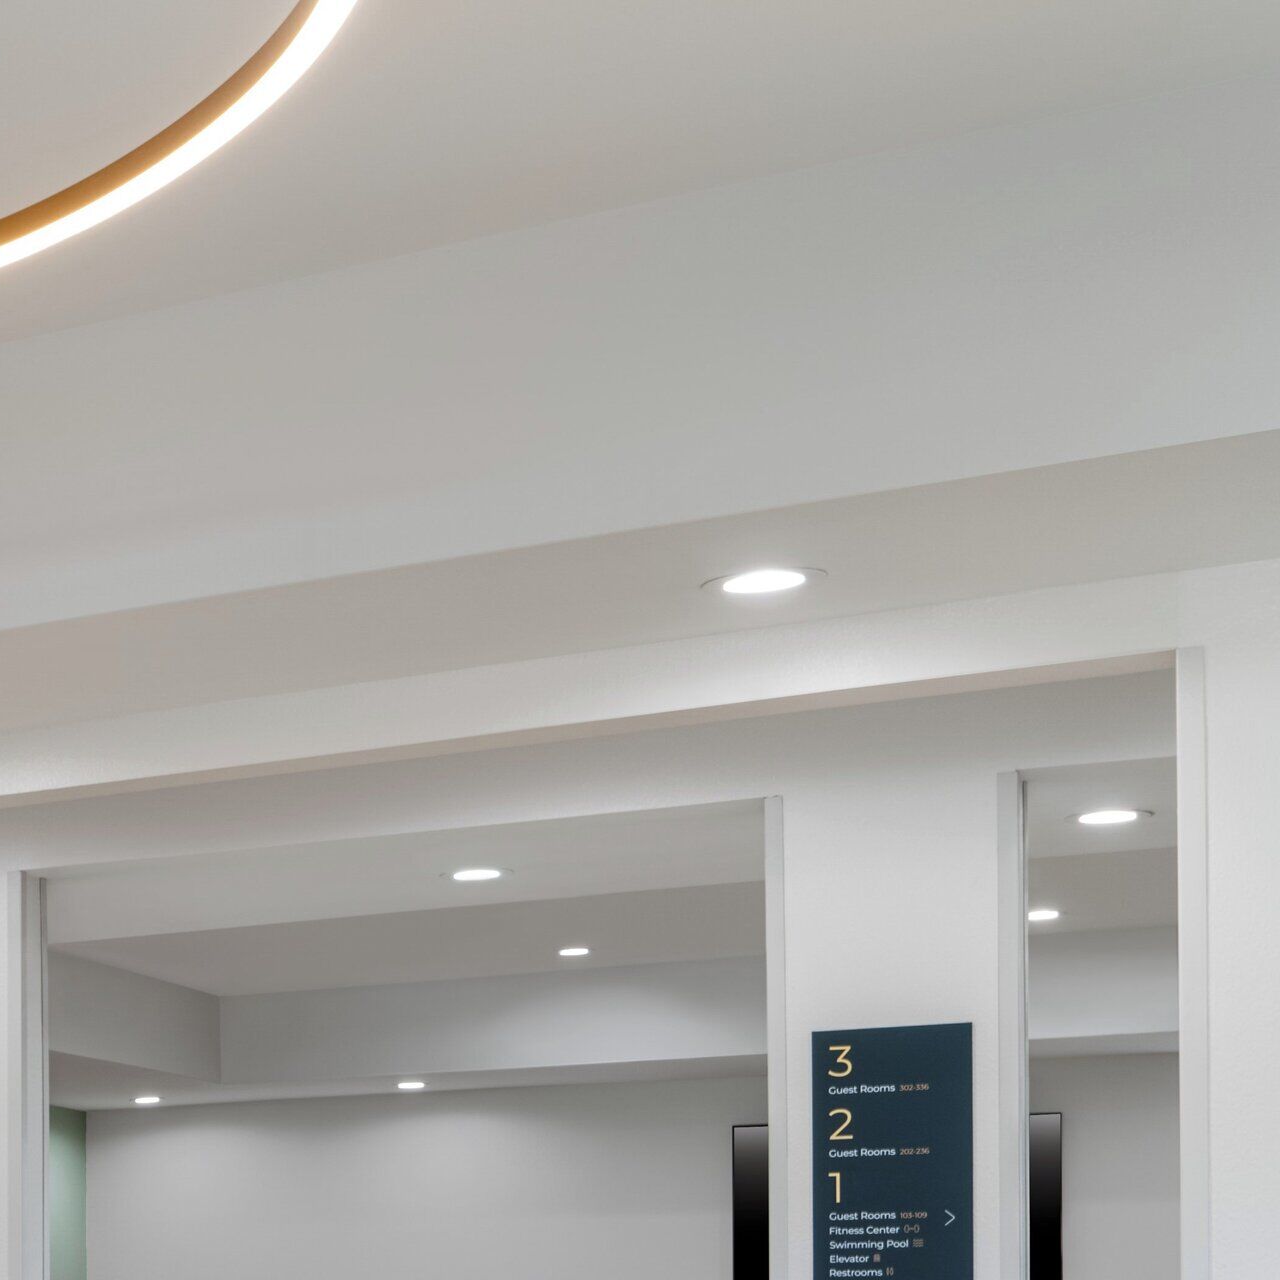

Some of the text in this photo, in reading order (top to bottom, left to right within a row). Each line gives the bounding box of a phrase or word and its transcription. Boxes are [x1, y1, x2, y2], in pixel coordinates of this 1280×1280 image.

[828, 1045, 853, 1078] 3
[828, 1083, 930, 1095] Guest Rooms 302-336
[828, 1108, 854, 1141] 2
[828, 1147, 930, 1158] Guest Rooms 202-236
[828, 1172, 841, 1203] 1
[829, 1211, 928, 1221] Guest Rooms 103-109
[829, 1225, 900, 1235] Fitness Center
[829, 1239, 909, 1251] Swimming Pool
[829, 1254, 869, 1263] Elevator
[829, 1268, 883, 1277] Restrooms
